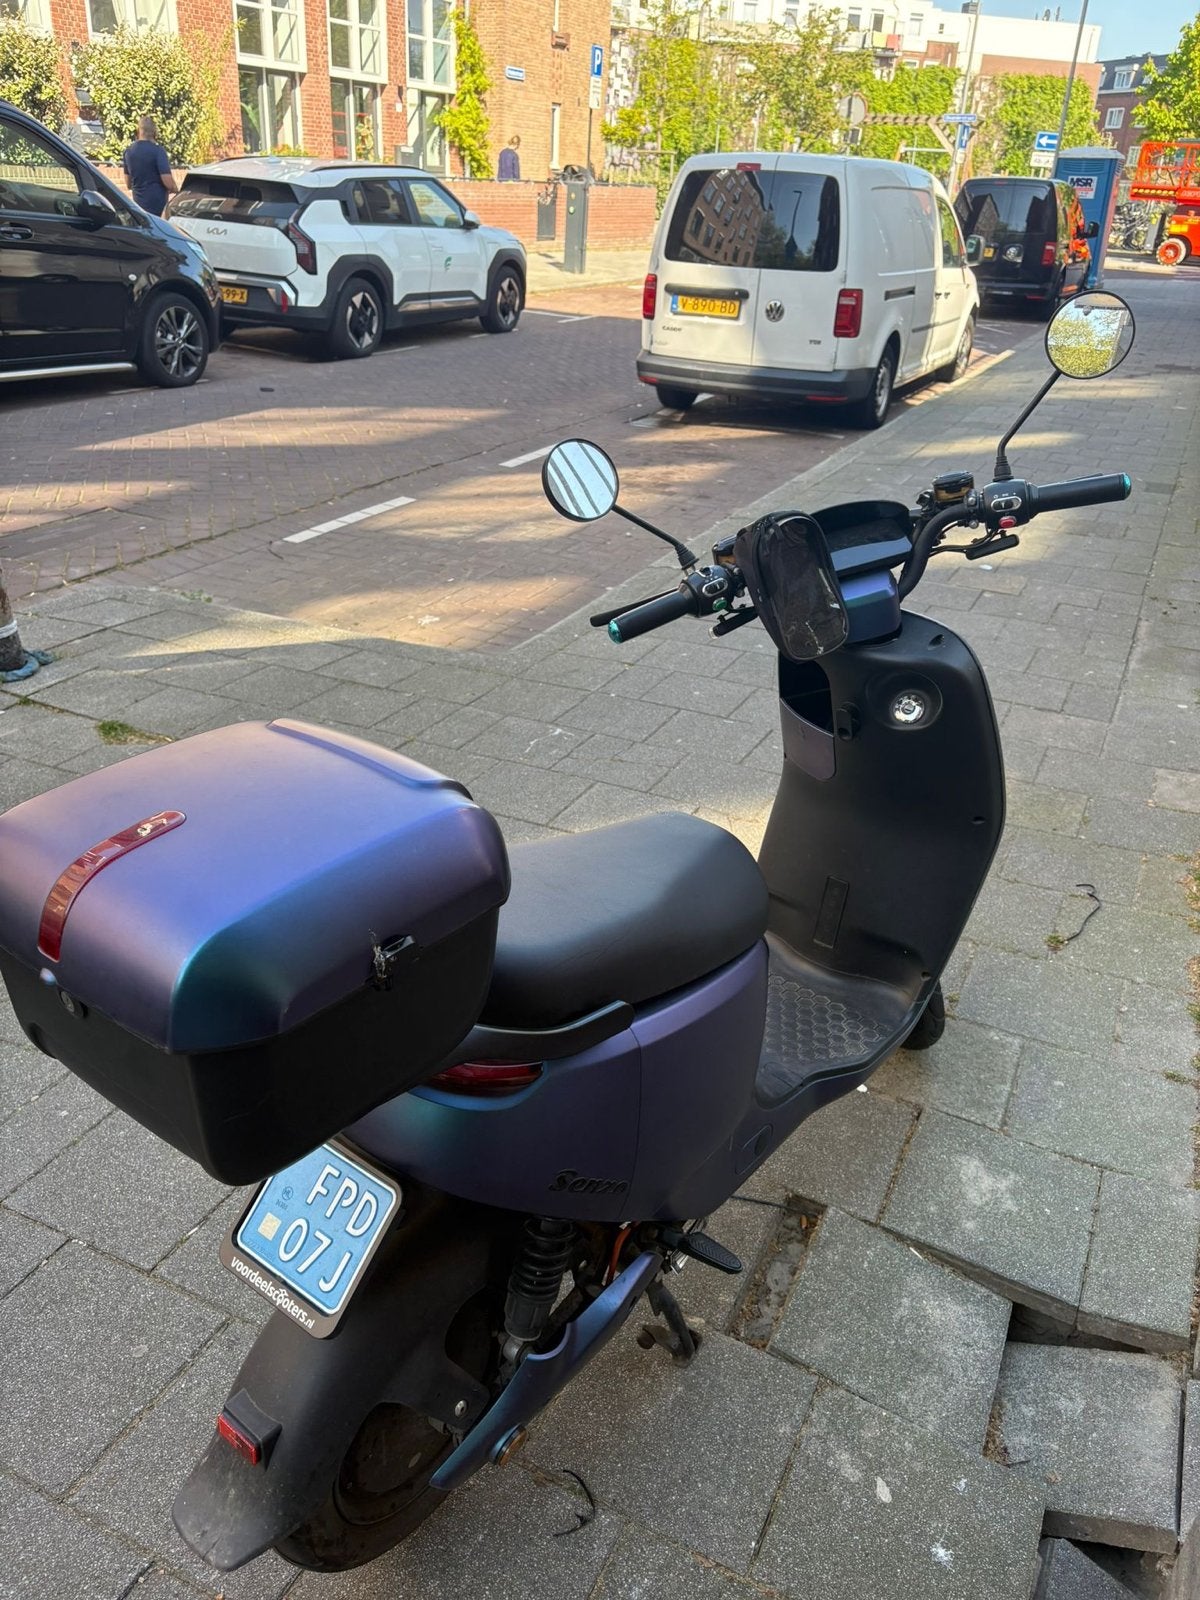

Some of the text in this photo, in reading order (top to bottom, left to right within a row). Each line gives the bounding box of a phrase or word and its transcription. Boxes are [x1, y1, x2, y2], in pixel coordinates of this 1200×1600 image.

[594, 48, 602, 74] P
[1069, 177, 1093, 187] MSR
[681, 298, 736, 314] V-890-BD
[548, 1168, 629, 1194] Senzo
[306, 1163, 379, 1237] FPD
[278, 1217, 352, 1293] 07J
[230, 1256, 316, 1330] voordeelscooters.nl
